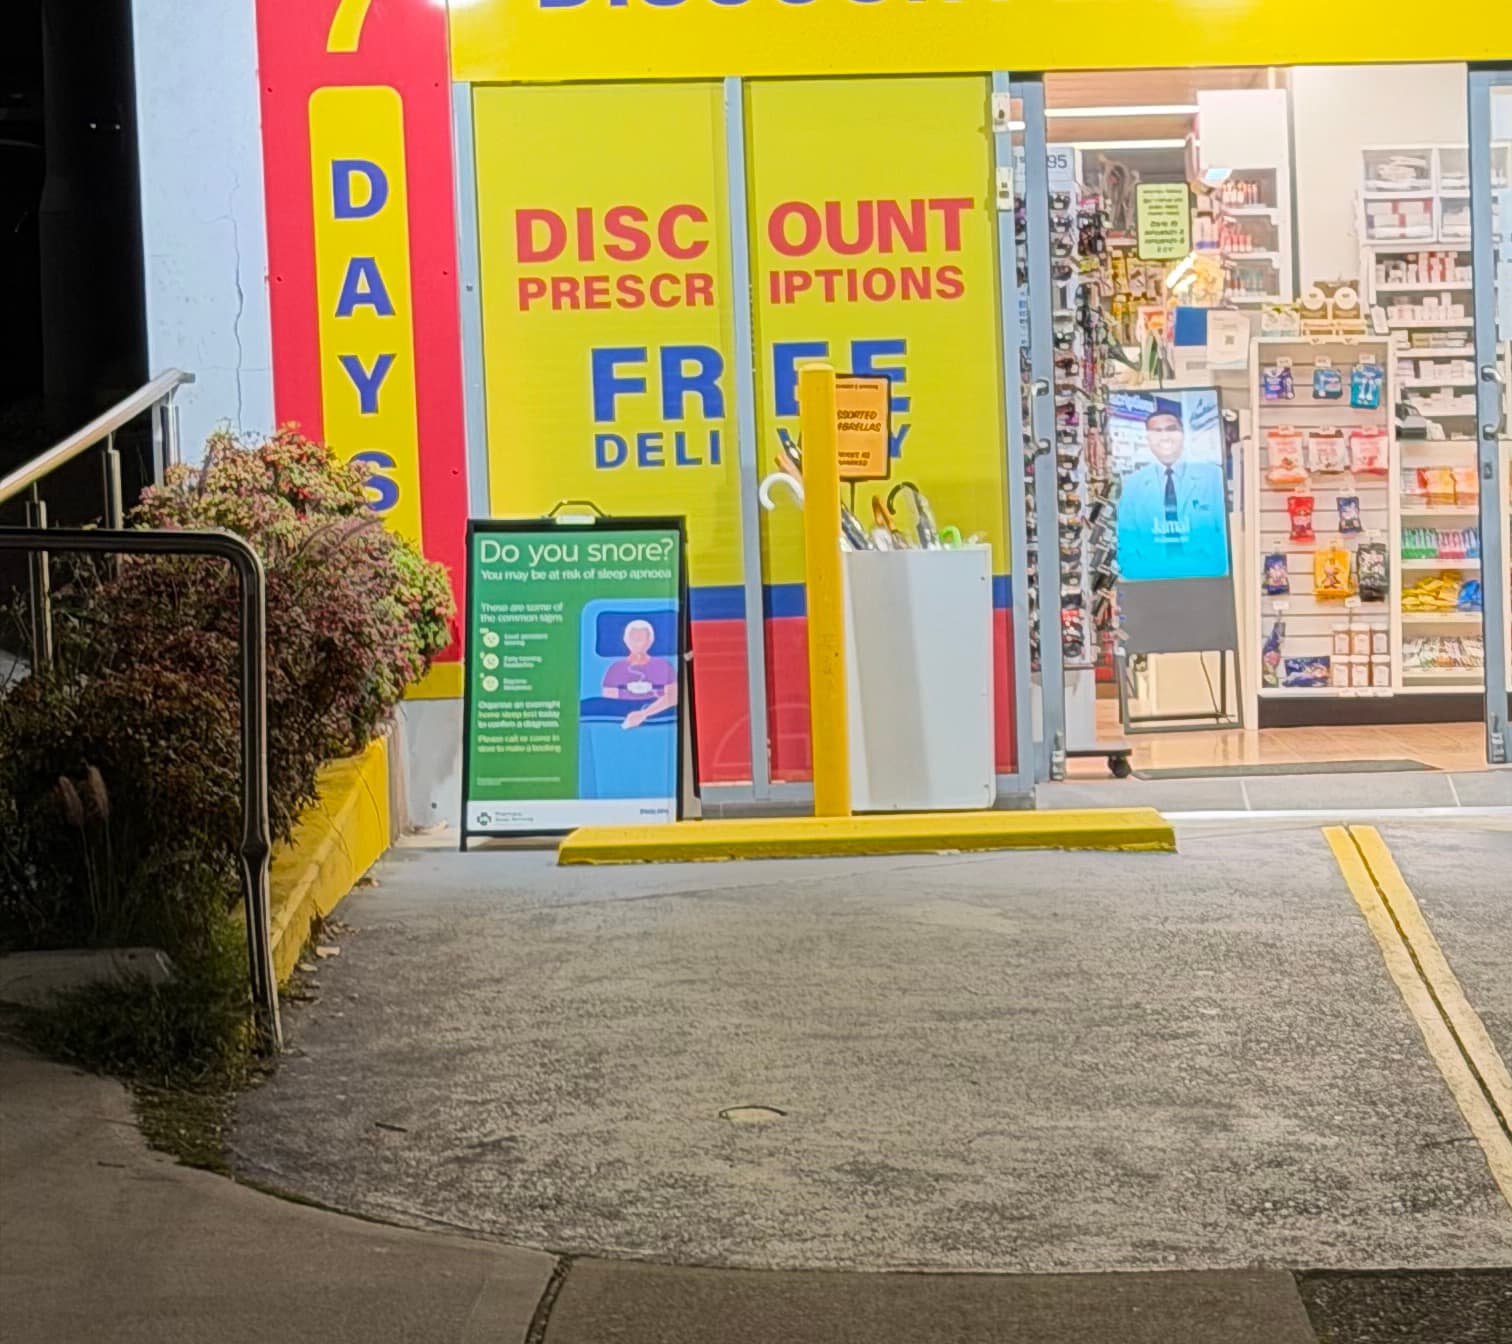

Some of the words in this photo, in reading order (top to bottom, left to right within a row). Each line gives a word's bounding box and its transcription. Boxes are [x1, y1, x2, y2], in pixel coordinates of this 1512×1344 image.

[480, 539, 519, 563] Do
[528, 543, 578, 567] you
[587, 538, 674, 562] snore?
[481, 570, 502, 580] You
[505, 571, 528, 582] may
[531, 570, 546, 580] be
[549, 570, 560, 580] at
[563, 569, 580, 579] risk
[583, 568, 596, 579] of
[598, 568, 627, 581] sleep
[630, 569, 672, 580] apnoea
